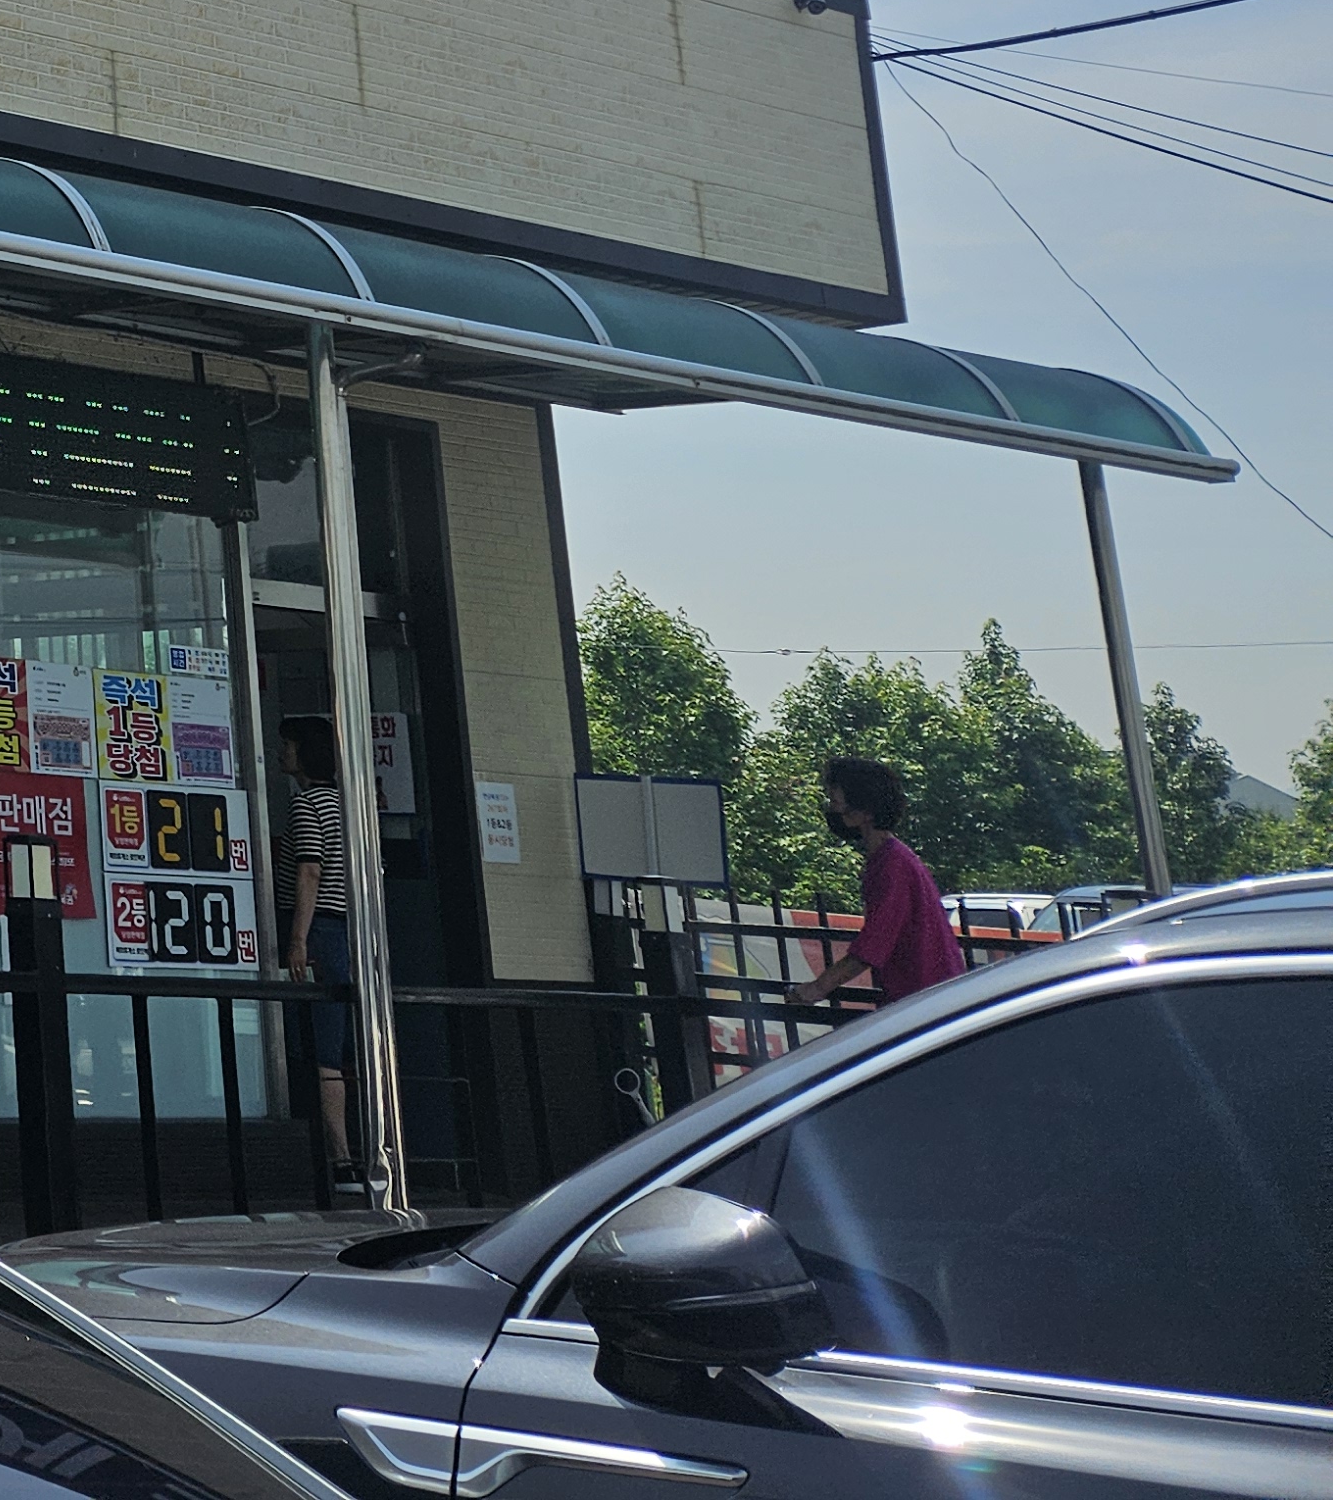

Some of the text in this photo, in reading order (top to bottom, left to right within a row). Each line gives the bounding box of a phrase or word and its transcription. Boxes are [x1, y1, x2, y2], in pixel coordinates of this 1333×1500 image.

[102, 674, 159, 709] 즉석
[106, 705, 159, 744] 1등
[105, 742, 163, 778] 당첨
[110, 803, 140, 834] 1등
[157, 798, 225, 862] 21
[230, 839, 249, 871] 번
[117, 896, 147, 928] 2등
[237, 930, 257, 963] 번
